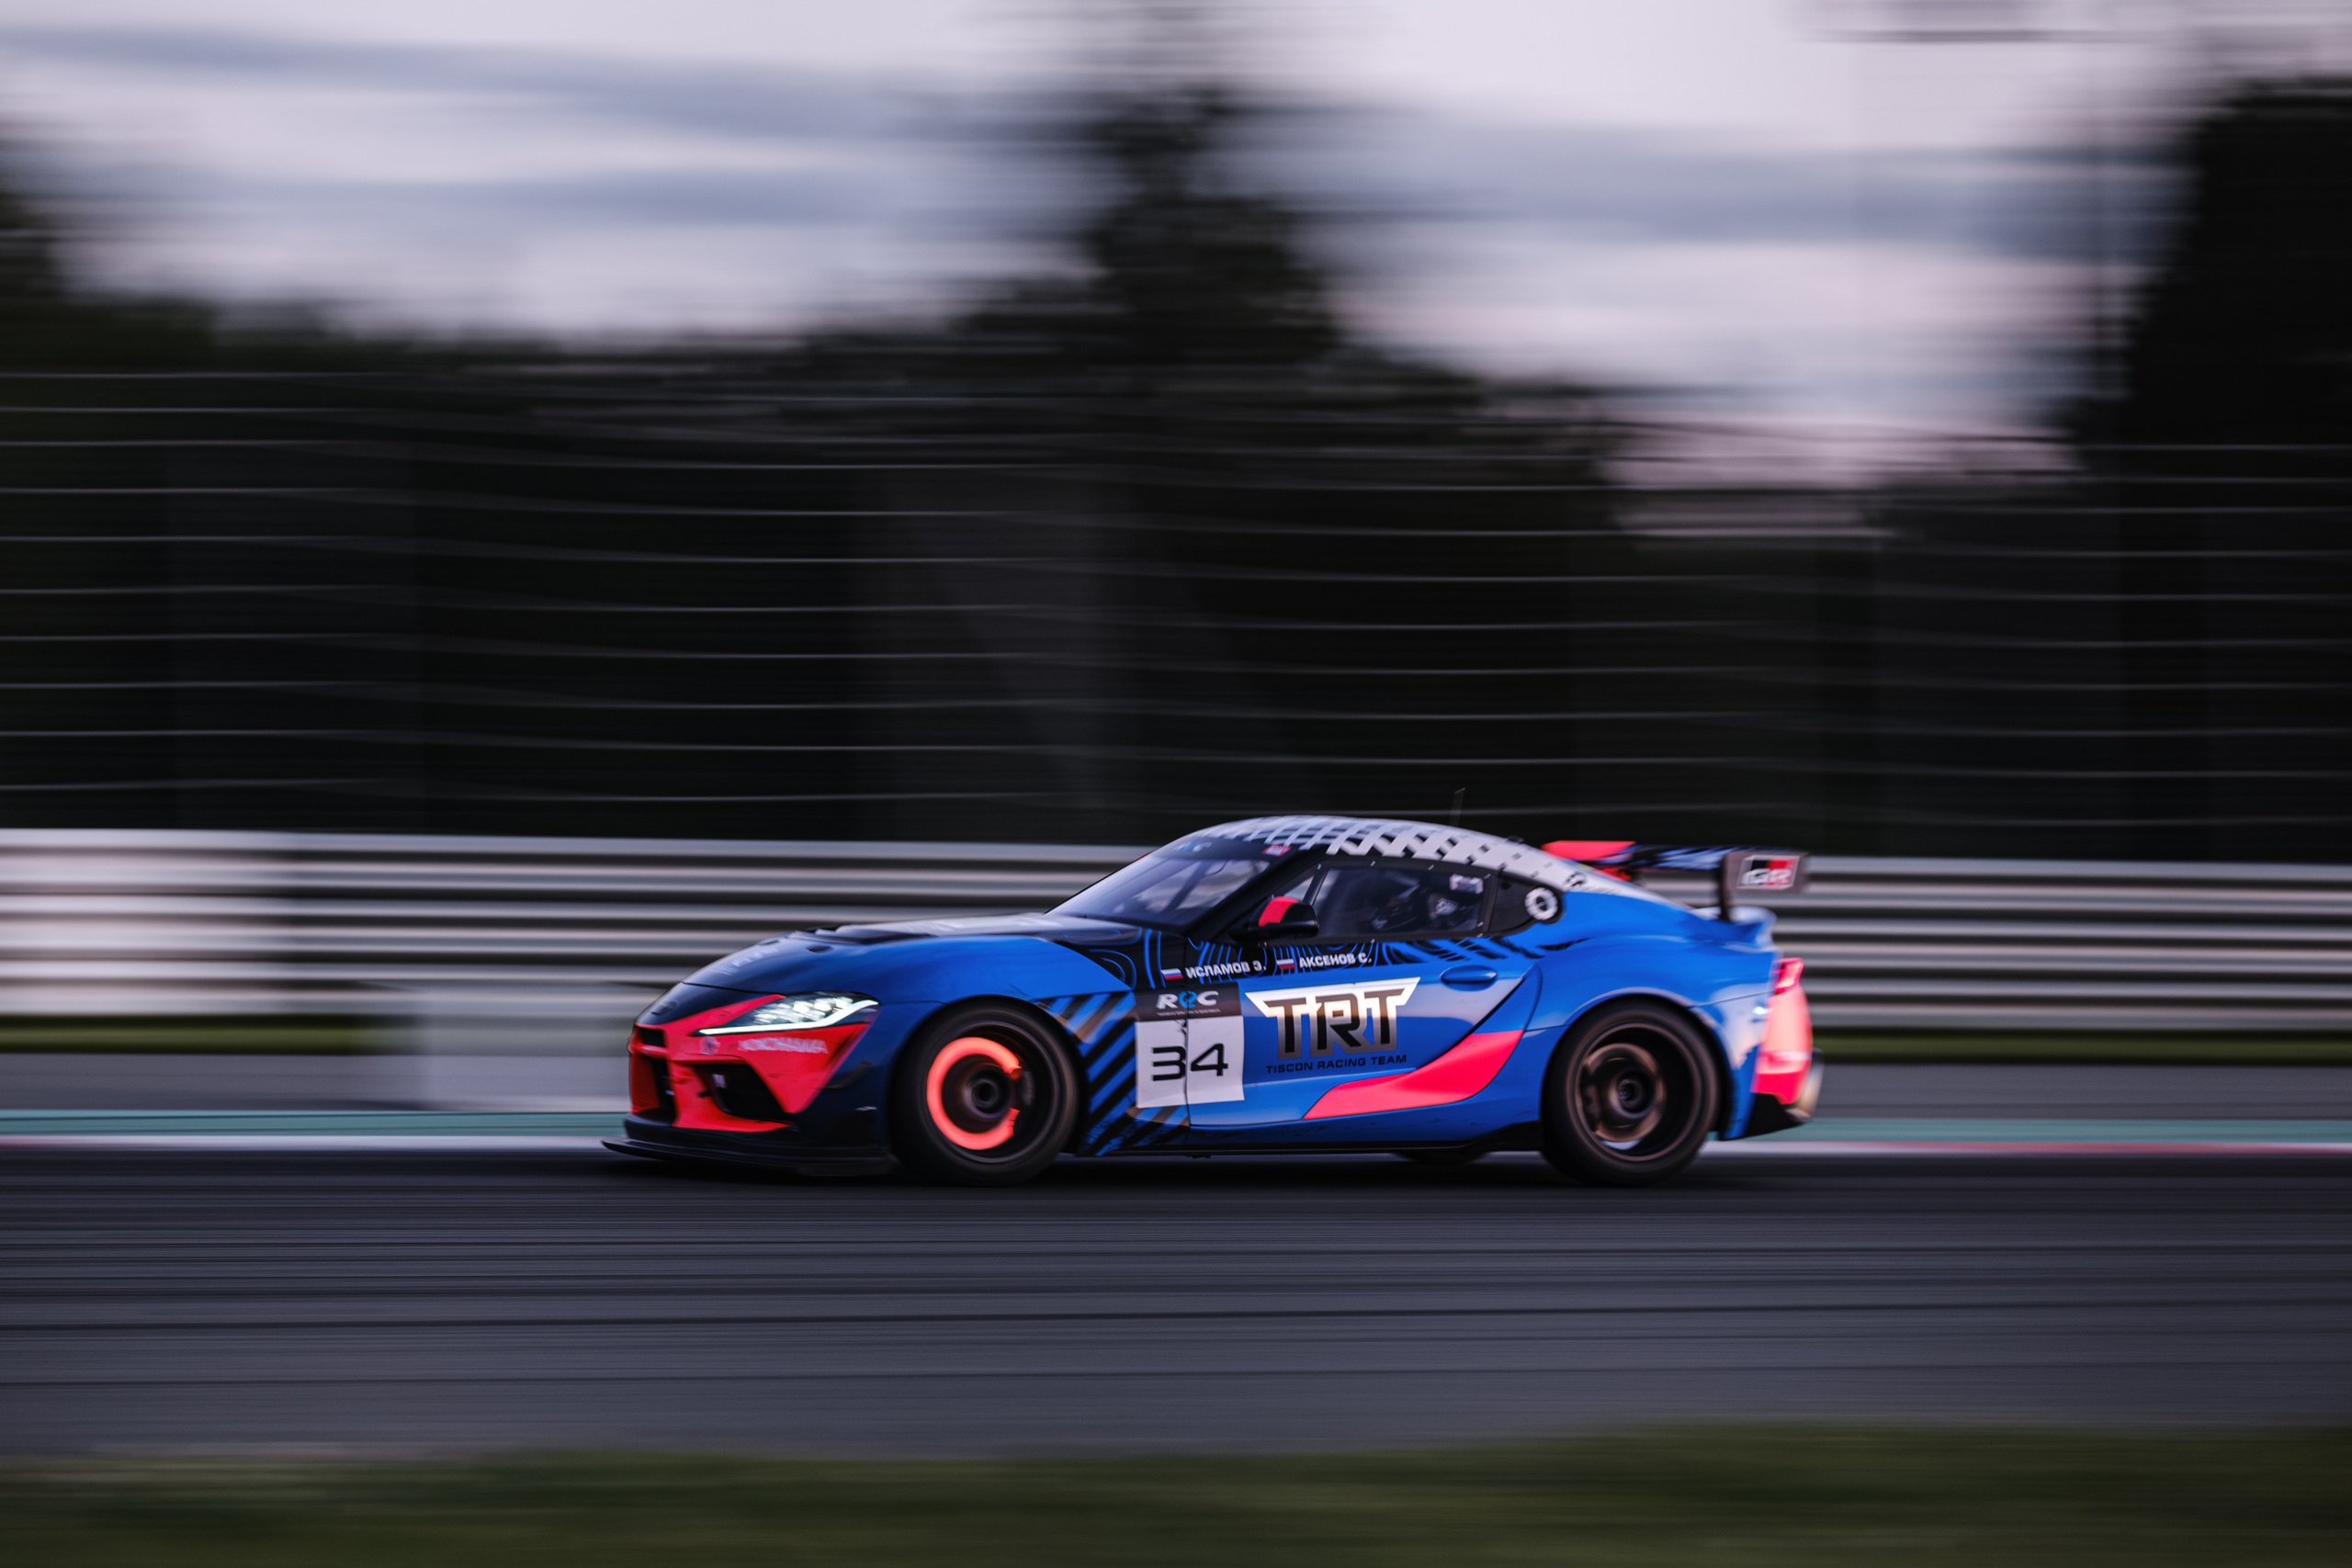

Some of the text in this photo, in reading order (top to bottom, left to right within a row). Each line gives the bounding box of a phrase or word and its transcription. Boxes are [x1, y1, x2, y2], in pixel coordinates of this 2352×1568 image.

[1185, 960, 1250, 979] ИСЛАМОВ
[1299, 953, 1356, 968] АКСЕНОВ
[1245, 976, 1421, 1061] TRT
[1151, 1043, 1229, 1081] 34
[1265, 1054, 1408, 1074] TISCON RACING TEAM
